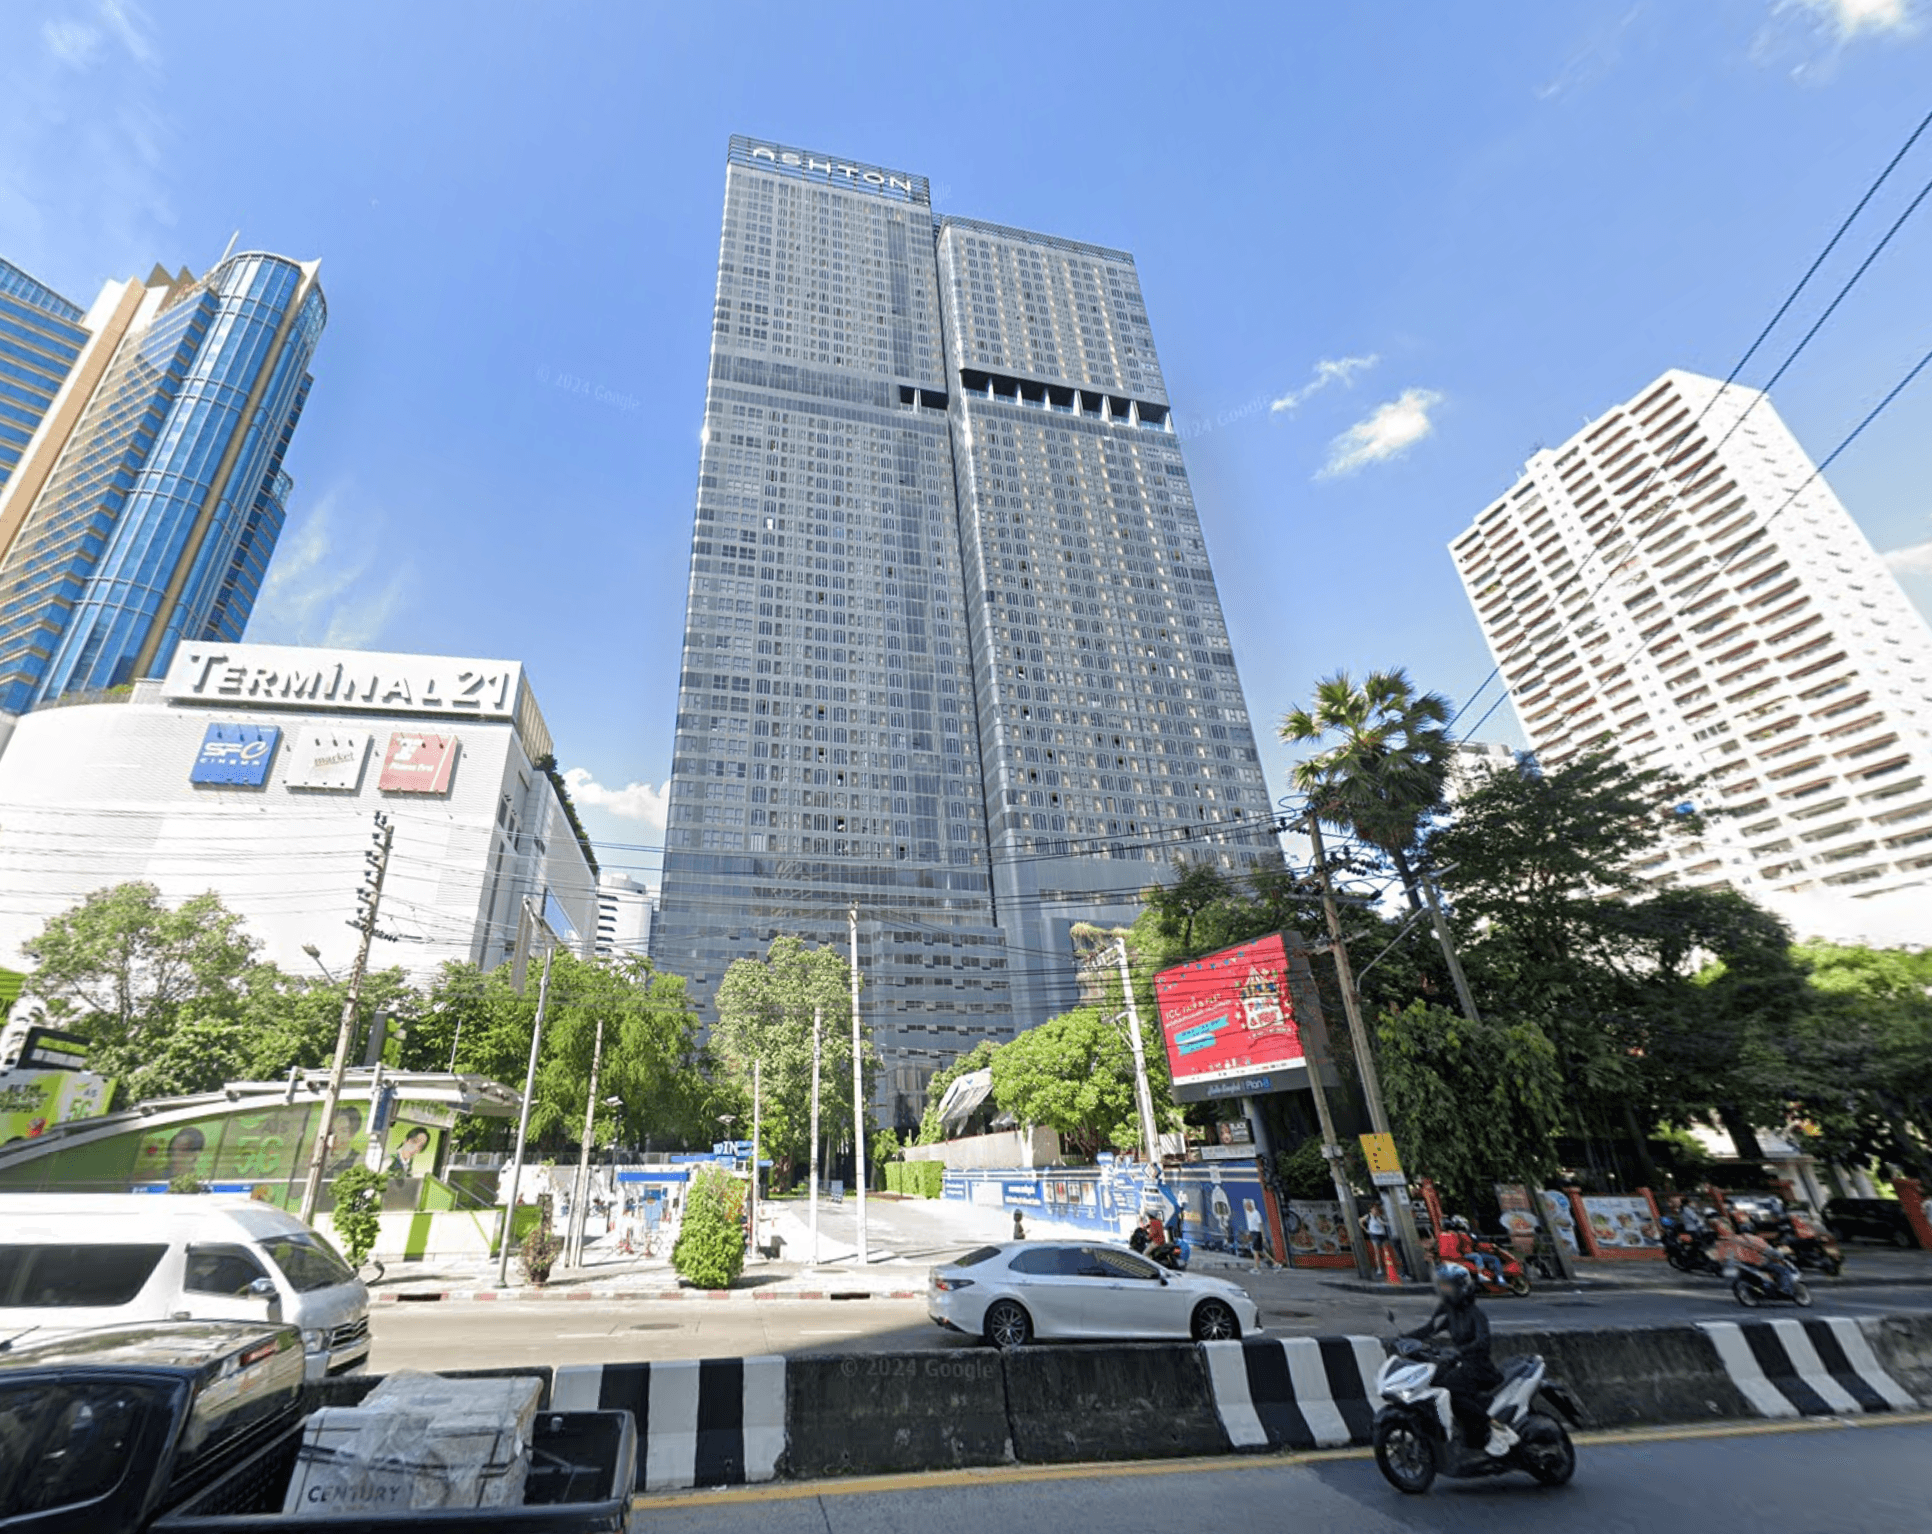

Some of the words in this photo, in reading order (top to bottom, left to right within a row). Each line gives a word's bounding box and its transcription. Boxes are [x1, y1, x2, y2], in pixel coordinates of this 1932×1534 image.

[752, 147, 911, 192] ASHTON
[190, 655, 442, 707] TERMINAL
[450, 671, 511, 710] 21
[314, 751, 355, 767] market
[234, 1136, 284, 1174] 5G
[307, 1485, 402, 1503] CENTURY
